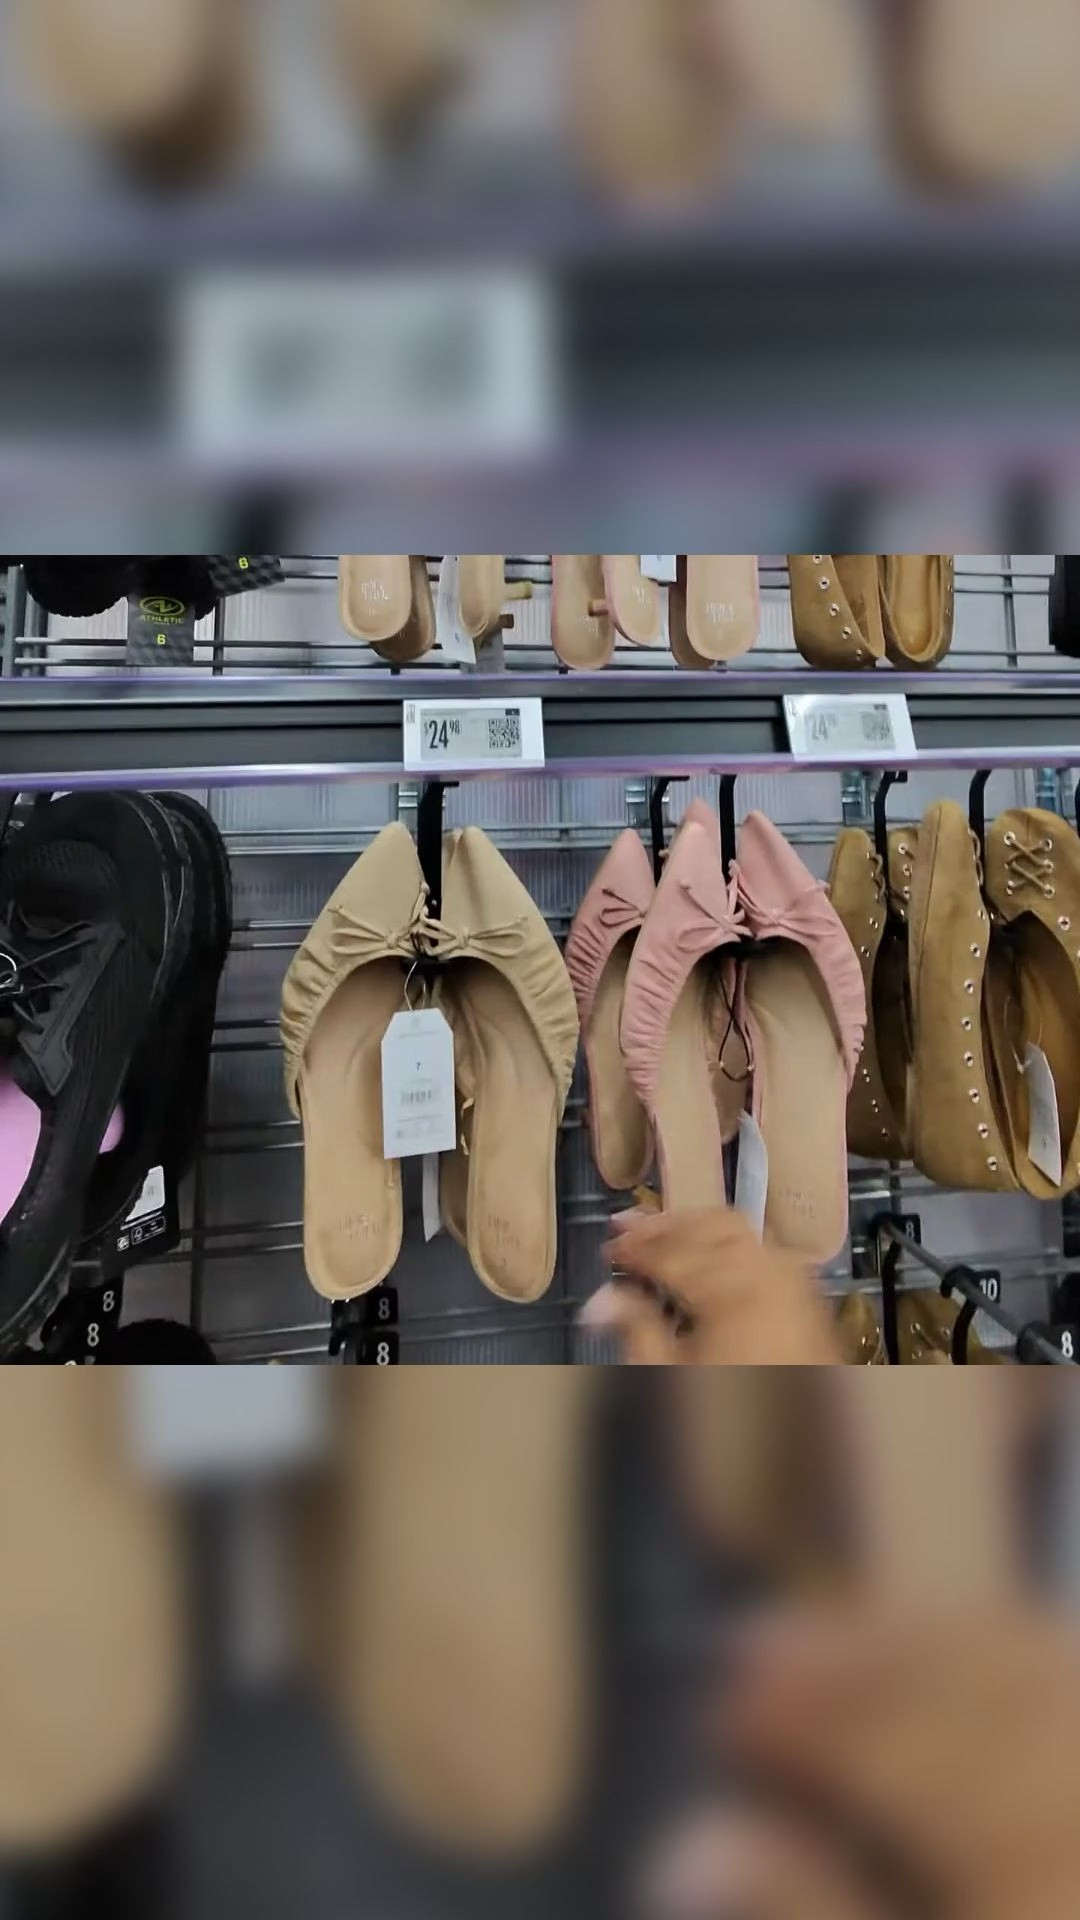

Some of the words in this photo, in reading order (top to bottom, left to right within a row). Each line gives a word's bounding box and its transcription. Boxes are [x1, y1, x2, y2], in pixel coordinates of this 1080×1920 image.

[239, 557, 248, 569] 6
[139, 614, 184, 624] ATHLETIC
[157, 634, 166, 645] 6
[905, 1221, 915, 1240] 8
[979, 1278, 998, 1300] 10
[103, 1290, 115, 1312] 8
[378, 1298, 390, 1319] 8
[87, 1322, 100, 1347] 8
[1061, 1331, 1074, 1358] 8
[376, 1342, 390, 1365] 8
